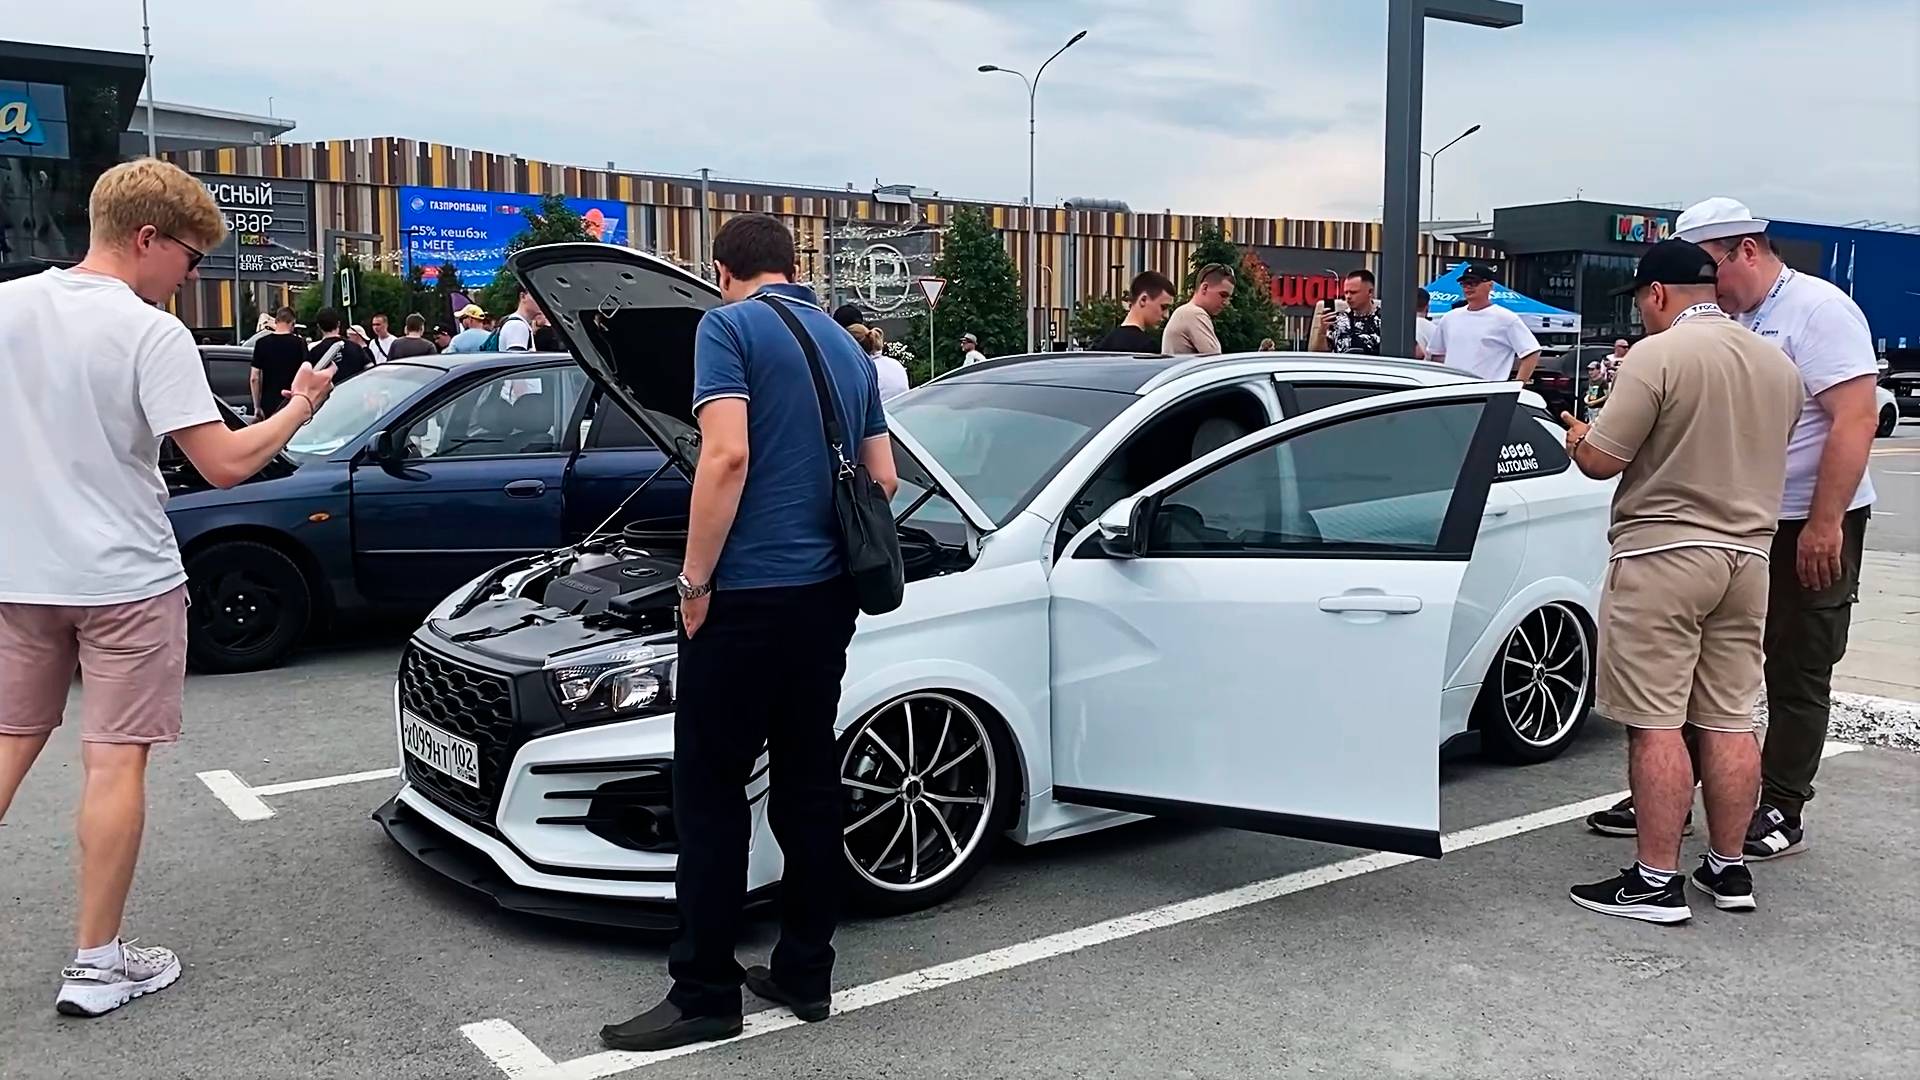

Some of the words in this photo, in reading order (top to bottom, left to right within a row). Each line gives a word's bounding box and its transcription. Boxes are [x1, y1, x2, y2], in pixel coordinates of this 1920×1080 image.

[204, 182, 273, 205] УСНЫЙ
[429, 200, 488, 213] ГАЗПРОМБАНК
[440, 227, 488, 240] кешбэк
[411, 241, 419, 249] в
[423, 240, 454, 251] МЕГЕ
[239, 254, 264, 263] LOVE
[1496, 457, 1539, 474] AUTOLING
[451, 741, 474, 772] 102
